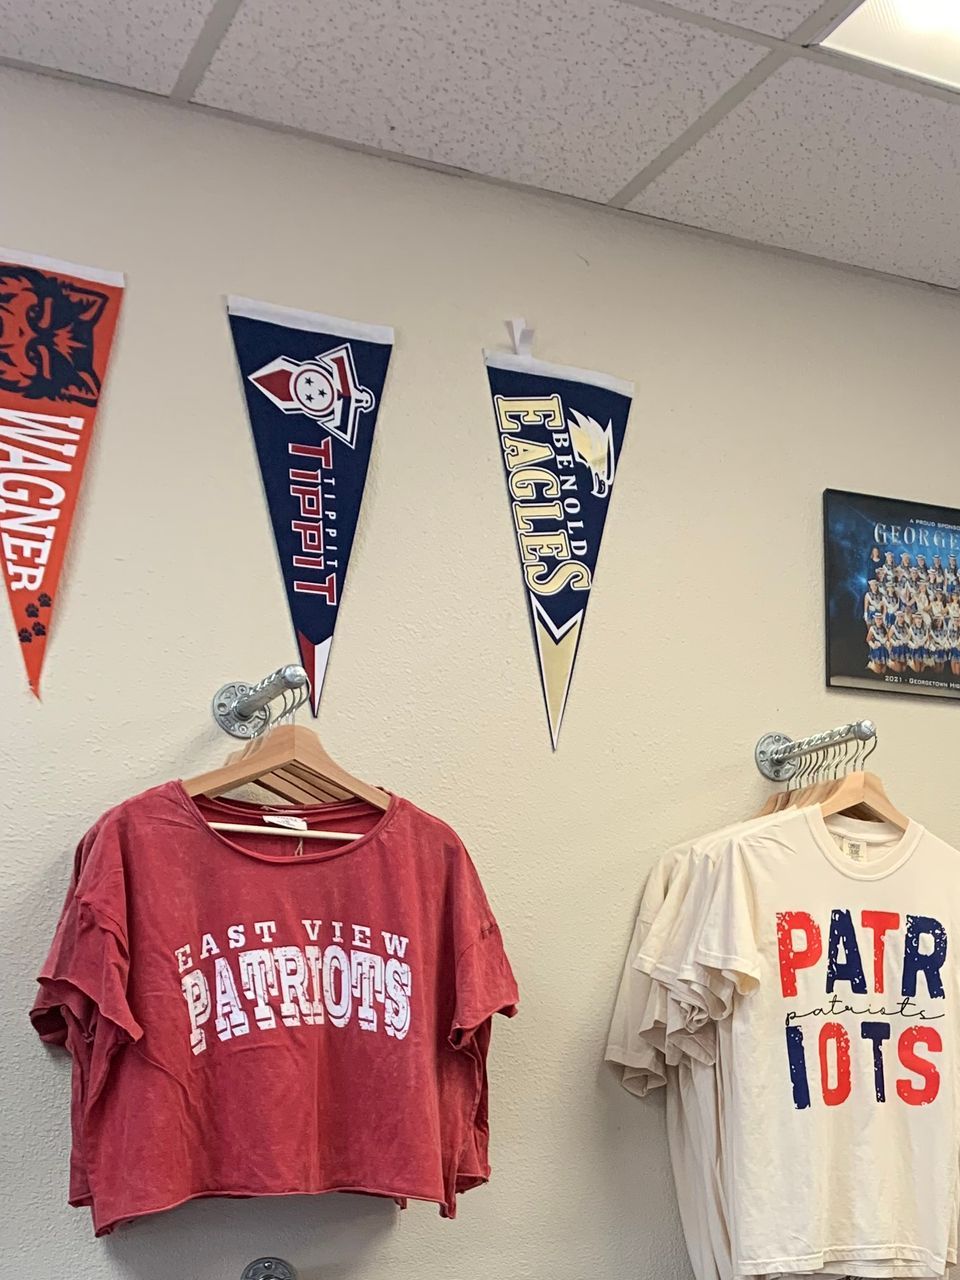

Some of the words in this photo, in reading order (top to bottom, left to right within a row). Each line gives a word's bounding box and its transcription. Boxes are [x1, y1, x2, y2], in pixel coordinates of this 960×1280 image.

[0, 408, 85, 592] WAGNER
[288, 435, 337, 606] TIPPIT
[323, 477, 338, 568] TIPPIT
[494, 394, 592, 595] EAGLES
[552, 432, 588, 556] BENOLD
[915, 519, 936, 528] PROUD
[175, 920, 277, 974] EAST
[302, 919, 409, 959] VIEW
[776, 908, 948, 1000] PATR
[181, 944, 412, 1056] PATRIOTS
[785, 994, 945, 1026] patriots
[785, 1020, 943, 1110] IOTS
